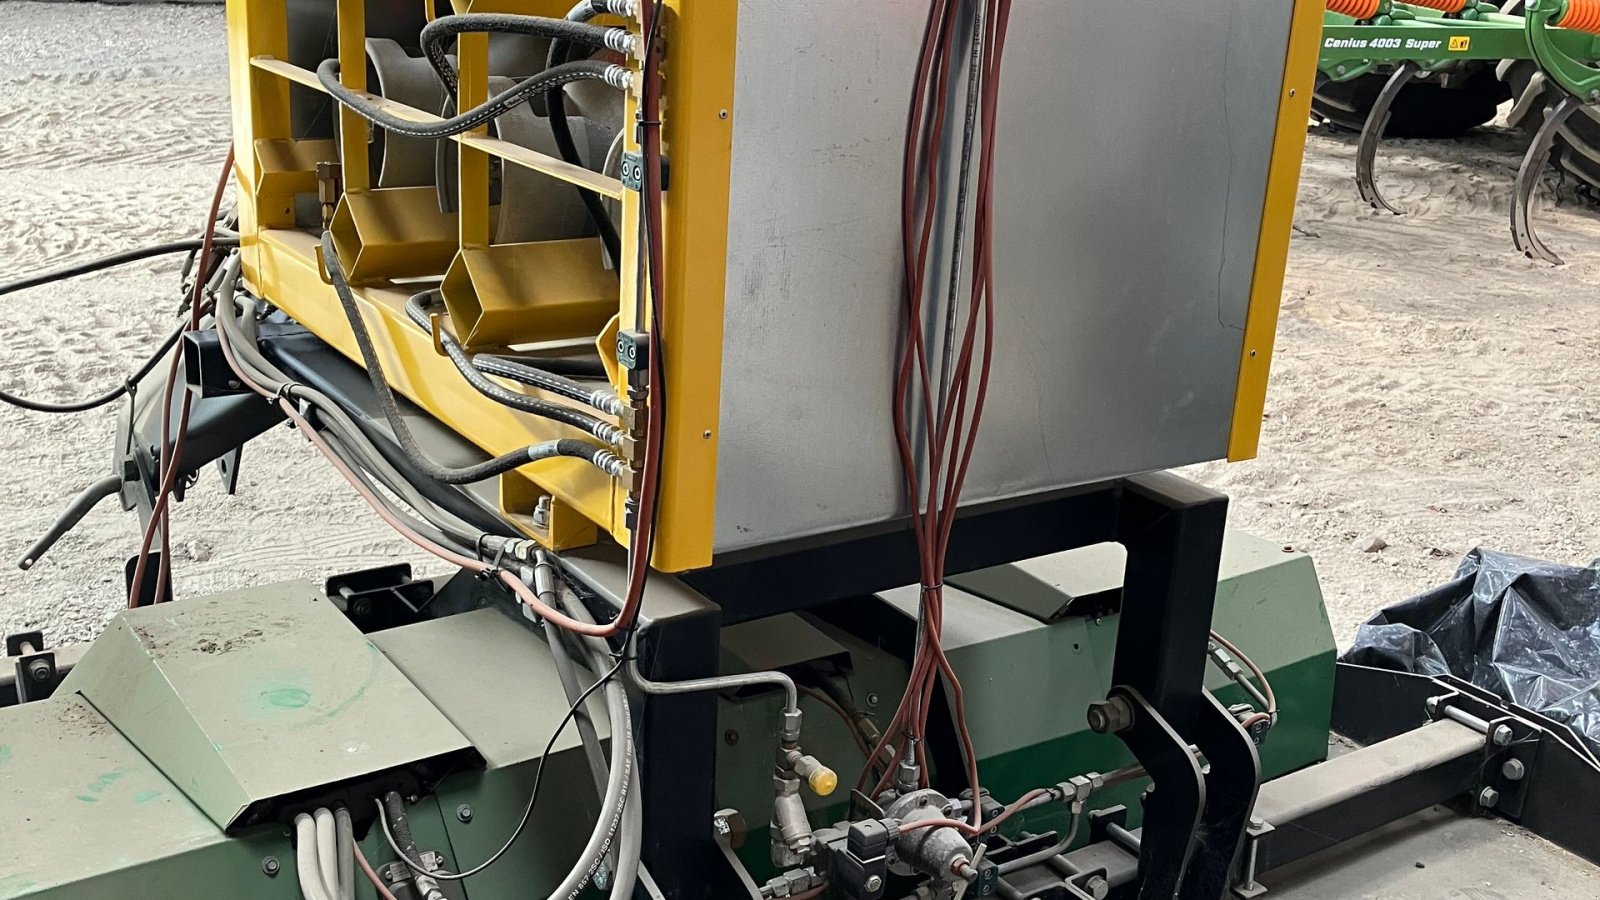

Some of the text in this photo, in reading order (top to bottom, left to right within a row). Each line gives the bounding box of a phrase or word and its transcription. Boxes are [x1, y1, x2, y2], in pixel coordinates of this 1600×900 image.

[1324, 37, 1442, 50] Cenius 4003 Super
[567, 889, 580, 900] EN
[577, 874, 589, 890] 857
[588, 857, 601, 875] 2SC
[600, 838, 611, 854] ISO
[608, 813, 621, 836] 11237
[617, 797, 626, 814] 2SC
[624, 757, 632, 775] SAE
